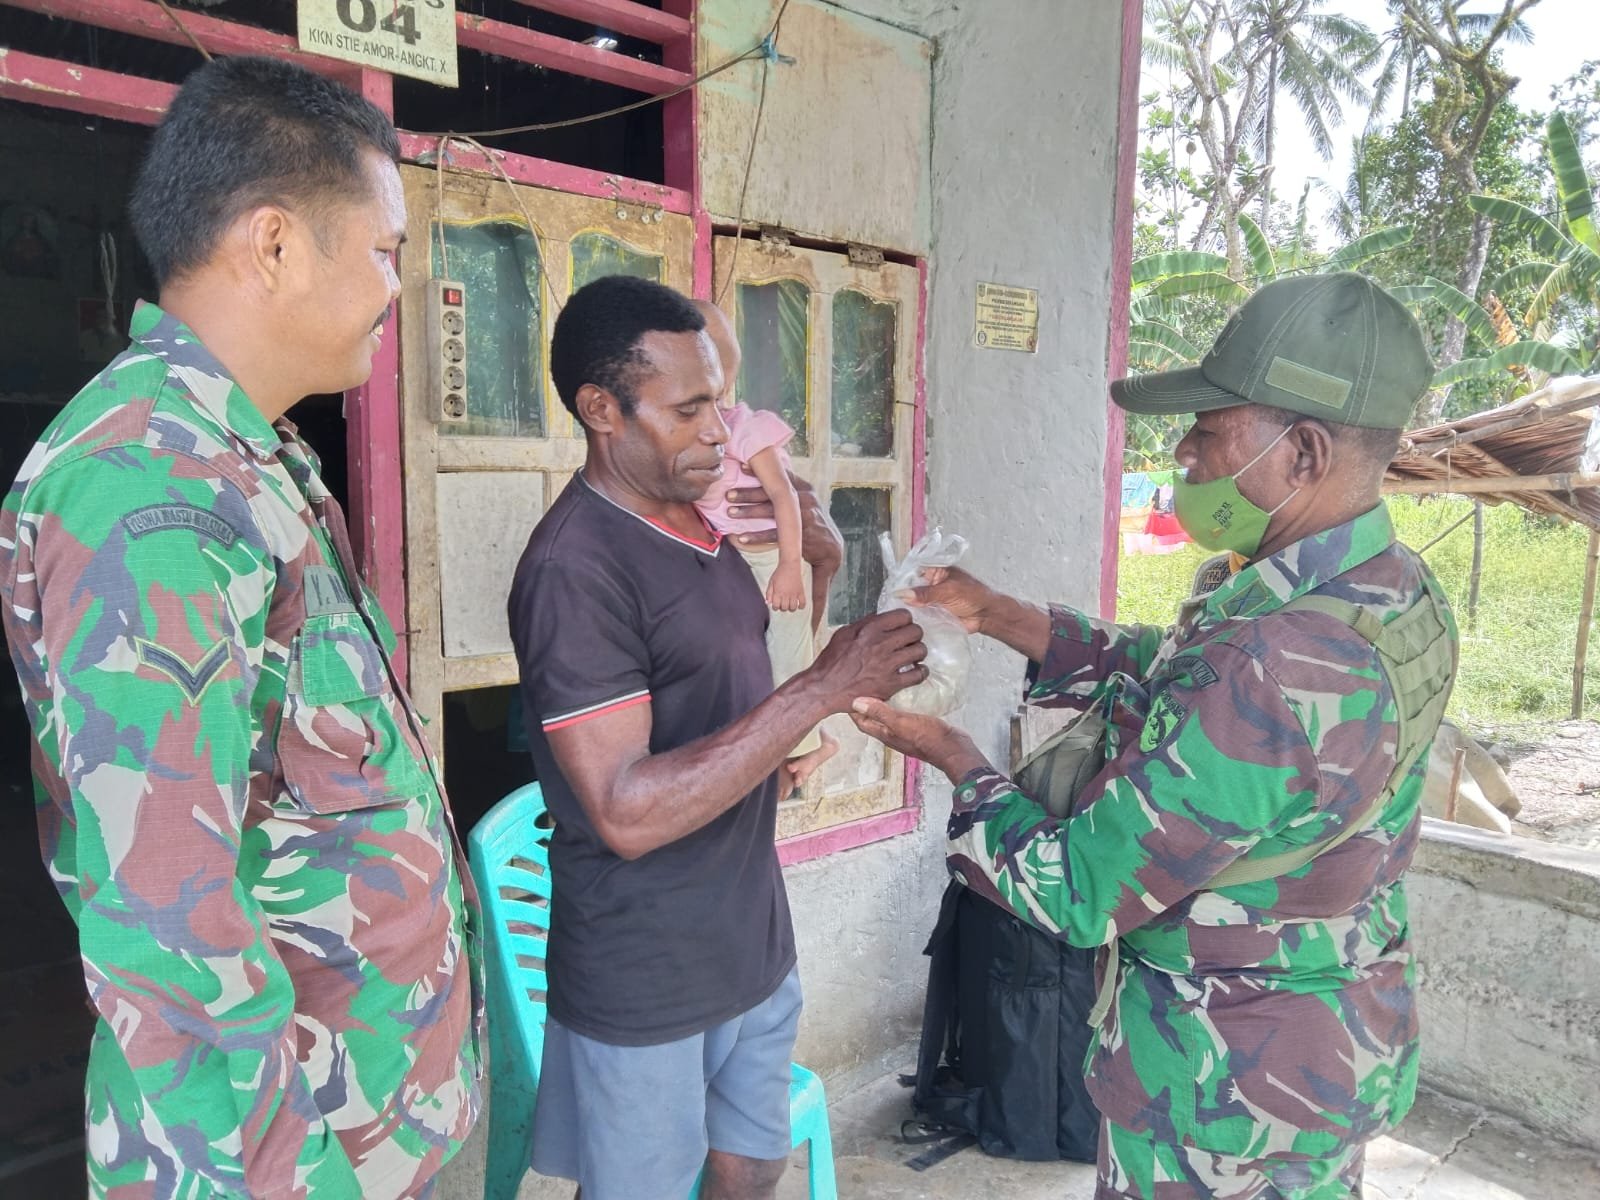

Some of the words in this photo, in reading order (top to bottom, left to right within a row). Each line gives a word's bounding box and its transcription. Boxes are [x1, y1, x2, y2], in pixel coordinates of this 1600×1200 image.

[336, 0, 421, 46] 04
[309, 28, 333, 47] KKN
[336, 34, 361, 53] STIE
[439, 59, 447, 73] X
